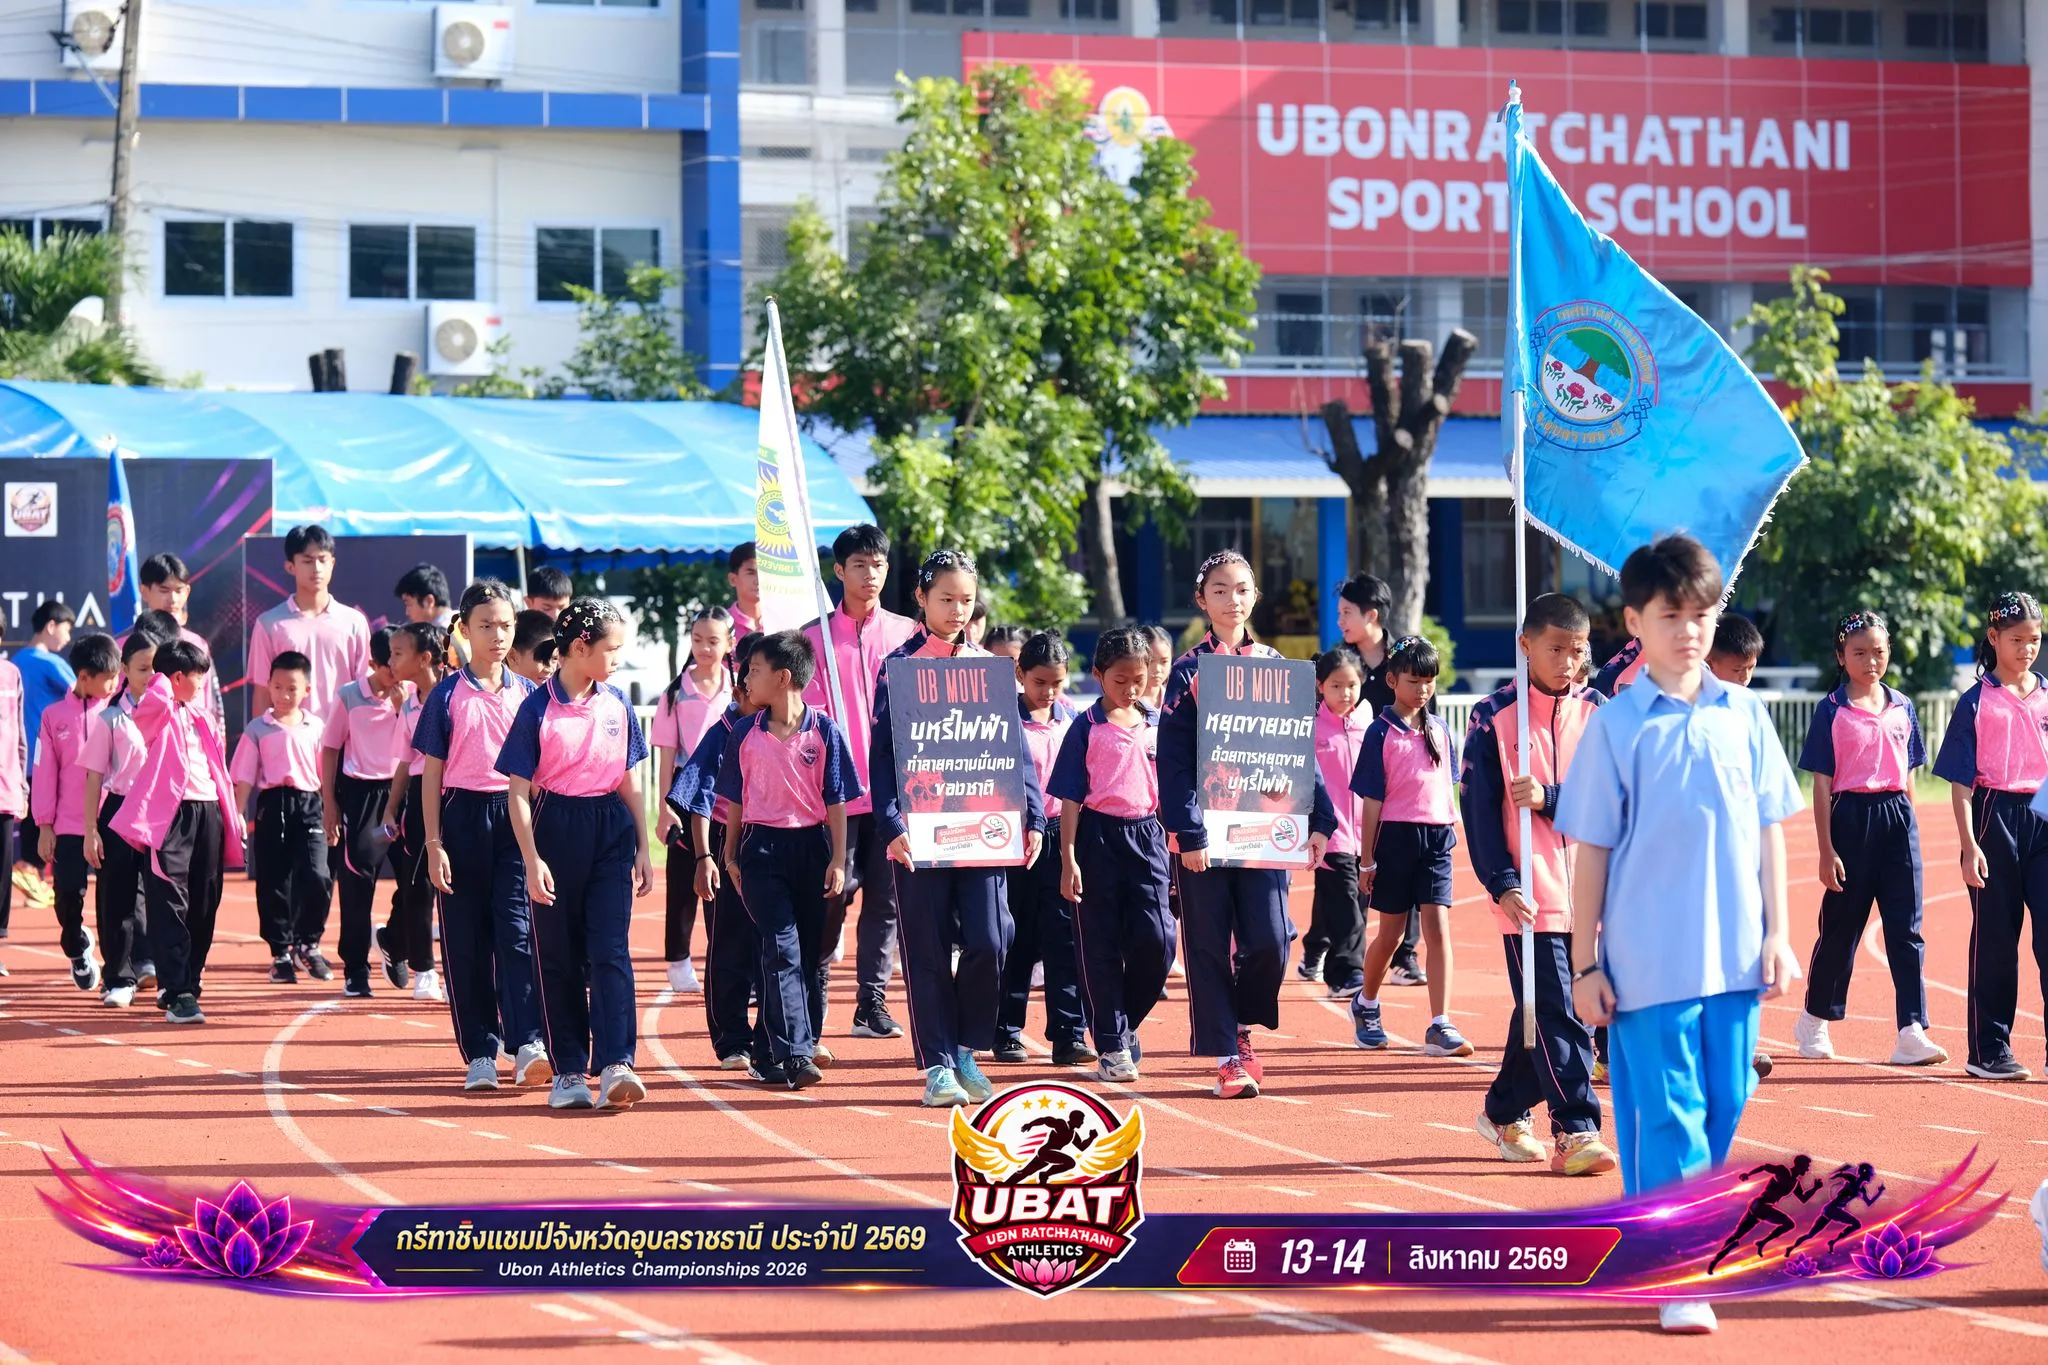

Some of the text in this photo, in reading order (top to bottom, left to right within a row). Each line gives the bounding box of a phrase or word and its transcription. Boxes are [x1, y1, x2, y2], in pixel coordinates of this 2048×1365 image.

[1327, 176, 1807, 239] SPORT SCHOOL
[916, 668, 989, 704] UB MOVE
[1226, 665, 1291, 704] UB MOVE
[910, 708, 1009, 753] บุหรี่ไฟฟ้า
[1204, 712, 1314, 743] หยุดขายชาติ
[1211, 744, 1306, 773] ด้วยการหยุดขาย
[934, 779, 995, 798] ของชาติ
[1227, 767, 1293, 798] บุหรี่ไฟฟ้า
